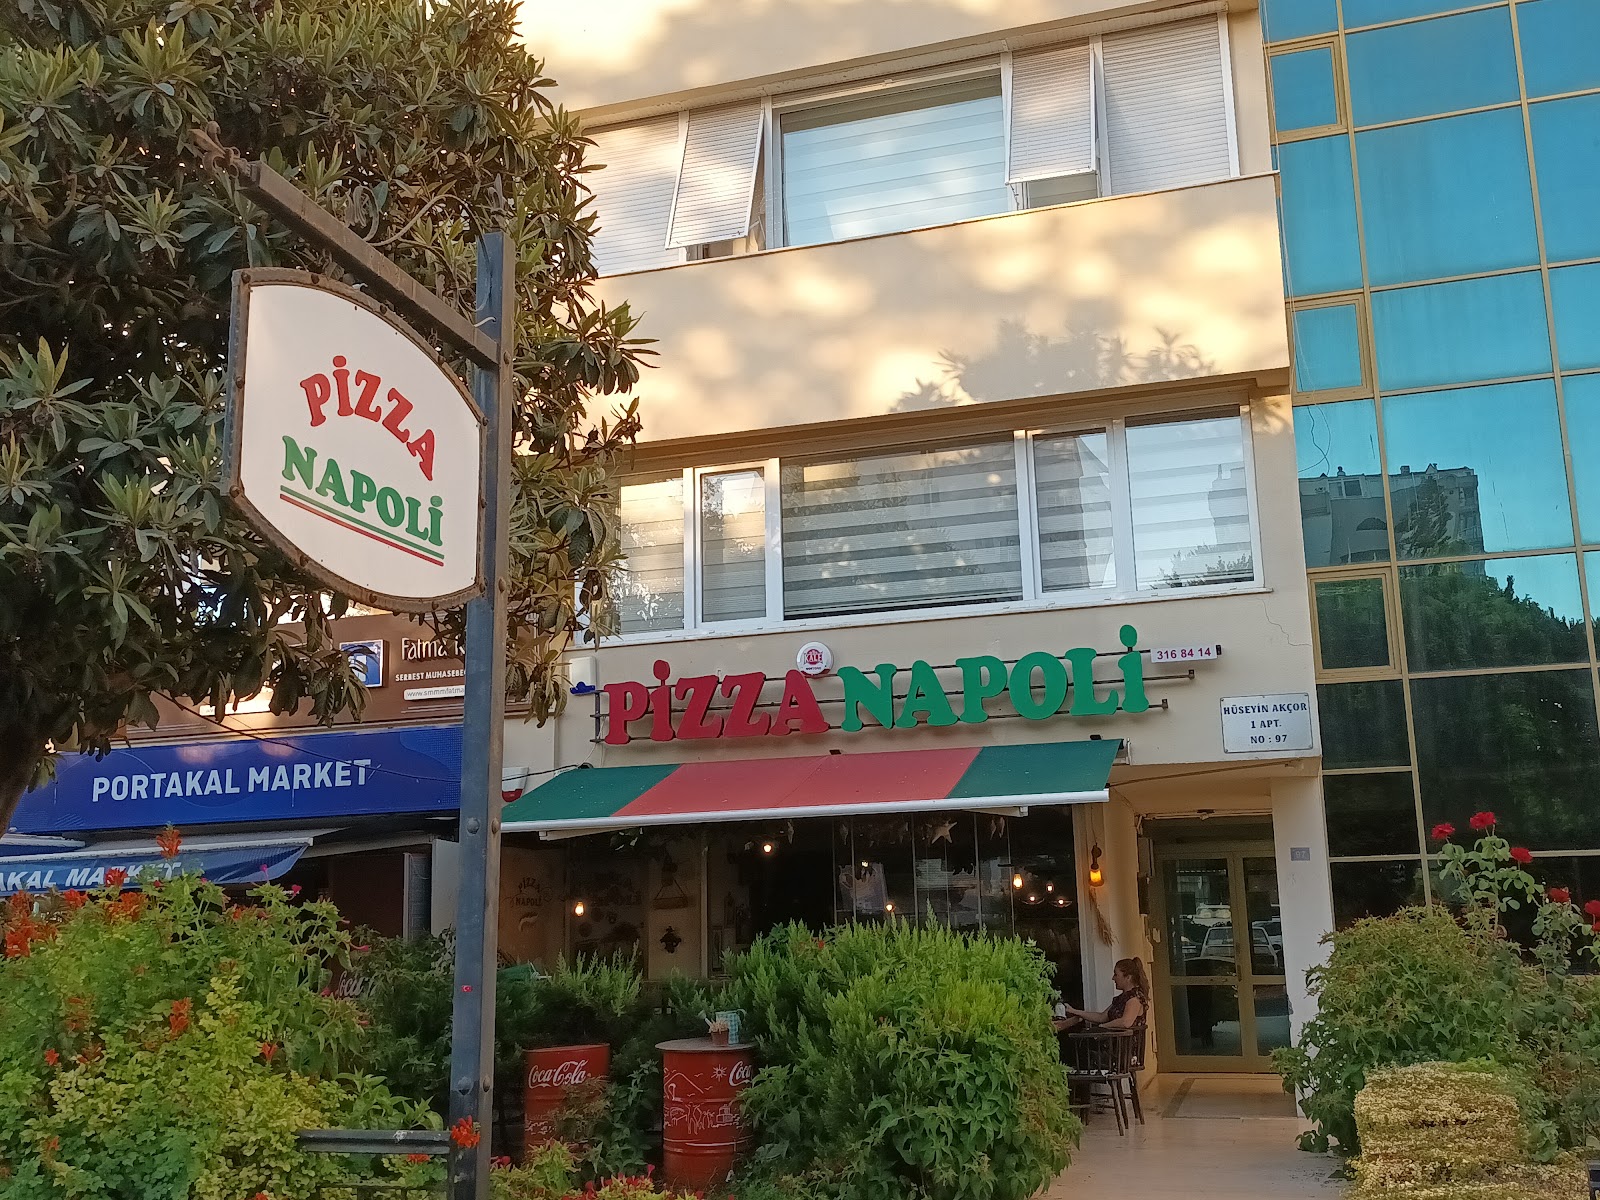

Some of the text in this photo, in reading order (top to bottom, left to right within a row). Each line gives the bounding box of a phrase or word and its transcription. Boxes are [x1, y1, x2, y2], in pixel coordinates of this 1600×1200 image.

[1157, 647, 1211, 660] 316 84 14
[395, 669, 466, 682] SERBEST MUHASEBE
[1223, 702, 1308, 715] HÜSEYİN AKÇOR
[1259, 719, 1282, 729] APT.
[1275, 734, 1288, 743] 97
[92, 758, 372, 802] PORTAKAL MARKET
